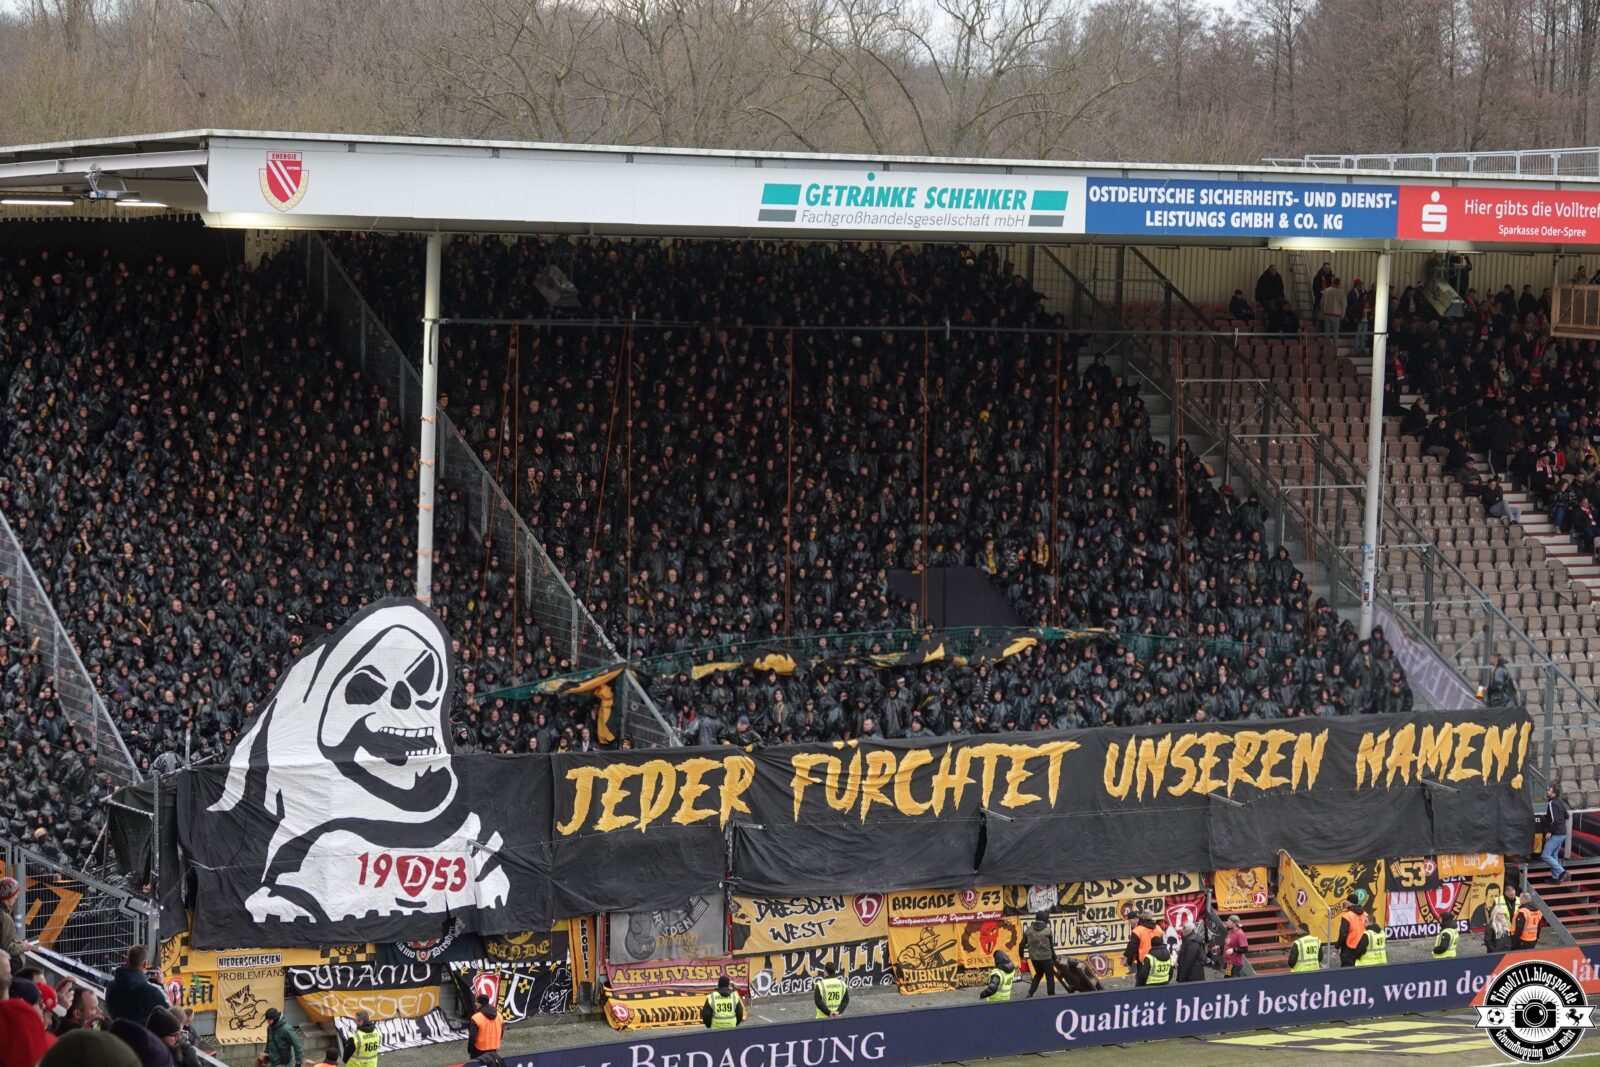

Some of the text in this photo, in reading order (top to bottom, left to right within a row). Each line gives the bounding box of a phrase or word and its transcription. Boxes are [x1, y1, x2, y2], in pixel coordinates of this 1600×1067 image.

[924, 186, 1027, 210] SCHENKER
[1089, 185, 1397, 209] OSTDEUTSCHE SICHERHEITS- UND DIENST-
[801, 210, 1025, 229] Fachgroßhandelsgesellschaft mbH
[1464, 199, 1492, 215] Hier
[1495, 200, 1528, 219] gibts
[1535, 201, 1552, 217] die
[1145, 210, 1343, 230] LEISTUNGS GMBH & CO. KG
[1498, 225, 1587, 238] Sparkasse Oder-Spree
[556, 721, 1532, 836] JEDER FÜRCHTET UNSEREN NAMEN!
[358, 851, 393, 888] 19
[431, 856, 467, 893] 53
[1400, 862, 1426, 887] 53
[752, 895, 845, 923] DRESDEN
[892, 893, 956, 911] BRIGADE
[981, 890, 1001, 906] 53
[769, 918, 836, 944] WEST
[218, 954, 281, 967] NIEDERSCHLESIEN
[1157, 960, 1170, 972] 337
[217, 967, 285, 981] PROBLEMFANS
[613, 963, 749, 984] AKTIVIST 53
[828, 991, 840, 1001] 276
[716, 1003, 733, 1013] 339
[1055, 1001, 1167, 1041] Qualität
[1175, 993, 1250, 1024] bleibt
[1257, 984, 1375, 1015] bestehen,
[1383, 977, 1448, 1002] wenn
[364, 1042, 378, 1052] 166
[629, 1031, 888, 1067] BEDACHUNG
